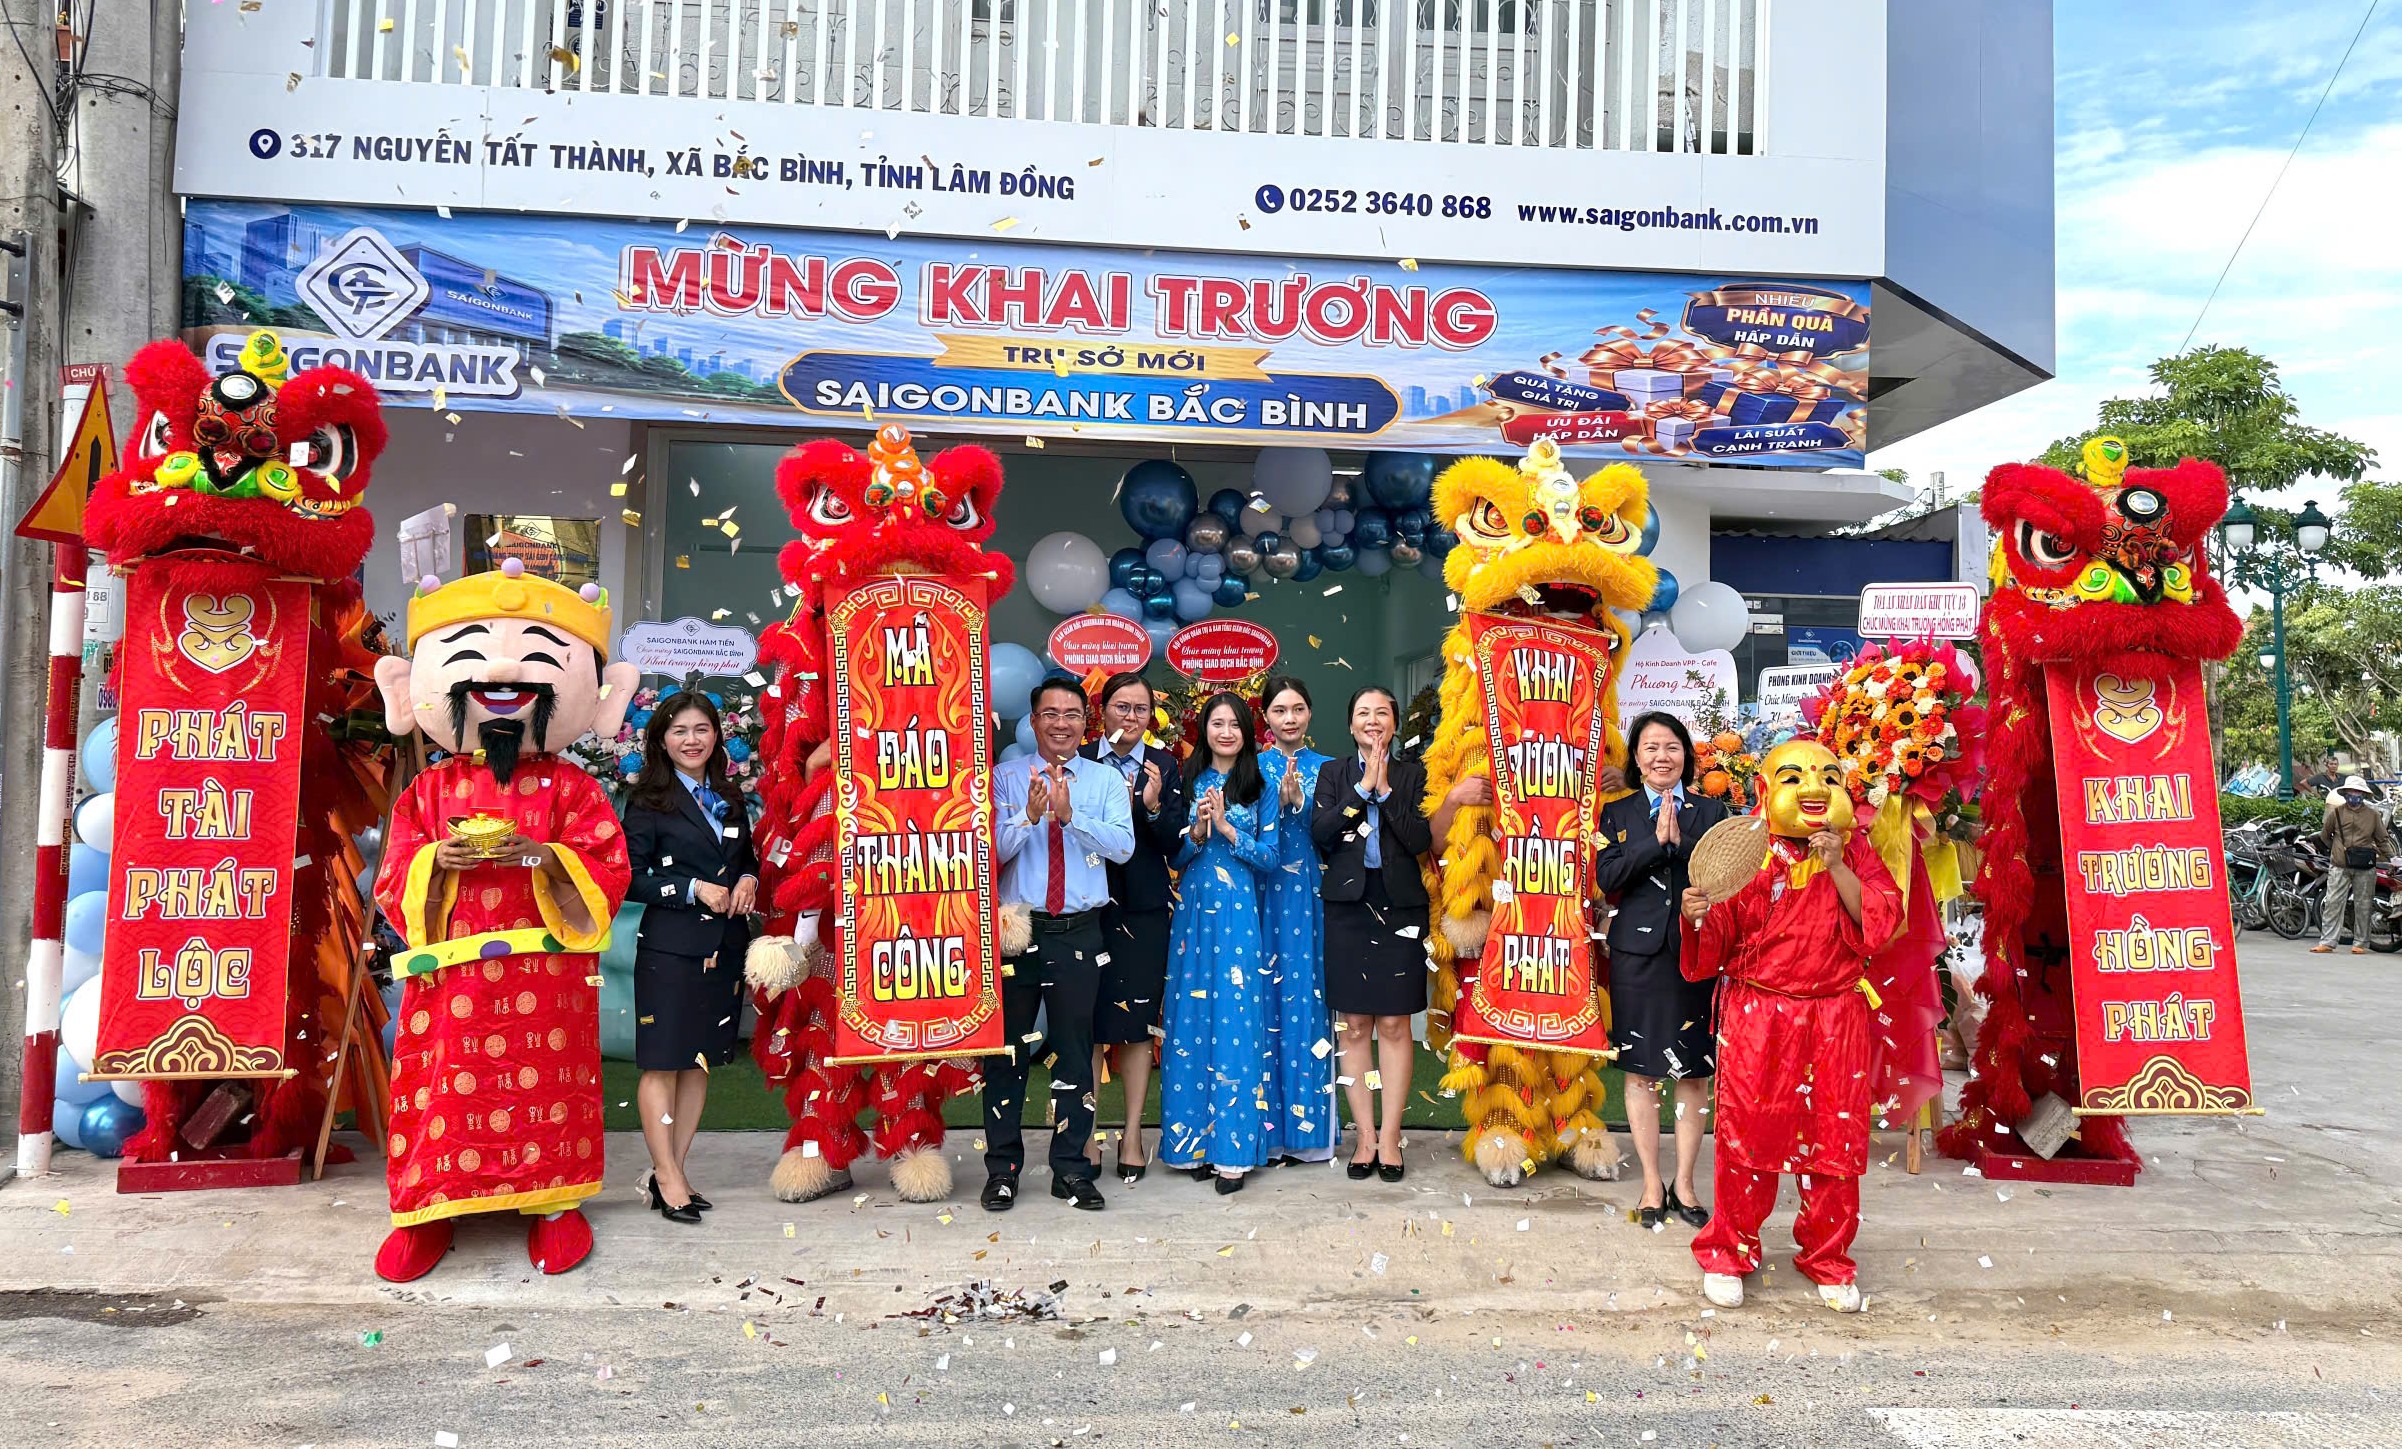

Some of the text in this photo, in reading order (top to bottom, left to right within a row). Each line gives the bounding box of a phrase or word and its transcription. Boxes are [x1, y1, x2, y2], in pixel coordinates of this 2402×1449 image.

[290, 133, 342, 159] 317
[353, 127, 472, 164] NGUYỄN
[485, 132, 538, 167] TẤT
[549, 140, 655, 178] THÀNH,
[666, 147, 703, 177] XÃ
[780, 153, 853, 191] BÌNH,
[860, 155, 923, 189] TỈNH
[932, 162, 991, 194] LÂM
[1000, 164, 1075, 200] ĐỒNG
[1290, 188, 1819, 235] 0252 3640 868 www.saigonbank.com.vn
[447, 290, 533, 321] SAIGONBANK
[626, 233, 1499, 348] MỪNG KHAI TRƯƠNG
[1726, 307, 1834, 332] PHẦN QUÀ
[1734, 329, 1815, 348] HẤP DẪN
[71, 366, 96, 378] CHÚ
[215, 343, 508, 386] SGONBANK
[1077, 345, 1125, 367] SỞ
[1137, 350, 1205, 371] MỚI
[815, 379, 1368, 430] SAIGONBANK BẮC BÌNH
[1513, 376, 1599, 400] QUÀ TẶNG
[1521, 390, 1580, 411] GIÁ TRỊ
[1546, 414, 1611, 427] ƯU ĐÃI
[1734, 426, 1806, 440] LÃI SUẤT
[1712, 439, 1822, 454] CẠNH TRANH
[646, 637, 698, 645] SAIGONBANK
[673, 648, 715, 656] SAIGONBANK
[1085, 654, 1099, 665] GIAO
[1204, 659, 1219, 668] GIAO
[1511, 647, 1577, 706] KHAI
[1764, 693, 1779, 706] Chúc
[1791, 673, 1808, 685] KINH
[1809, 672, 1832, 684] DOANH
[136, 700, 286, 761] PHÁT
[876, 714, 951, 791] ĐÁO
[159, 778, 254, 840] TÀI
[2083, 774, 2194, 825] KHAI
[855, 818, 977, 896] THÀNH
[1502, 813, 1577, 898] HỒNG
[2079, 845, 2212, 895] TRƯƠNG
[123, 857, 277, 920] PHÁT
[872, 923, 967, 1002] CÔNG
[1501, 923, 1571, 997] PHÁT
[2094, 915, 2215, 972] HỒNG
[136, 938, 254, 1010] LỘC
[2102, 992, 2216, 1042] PHÁT
